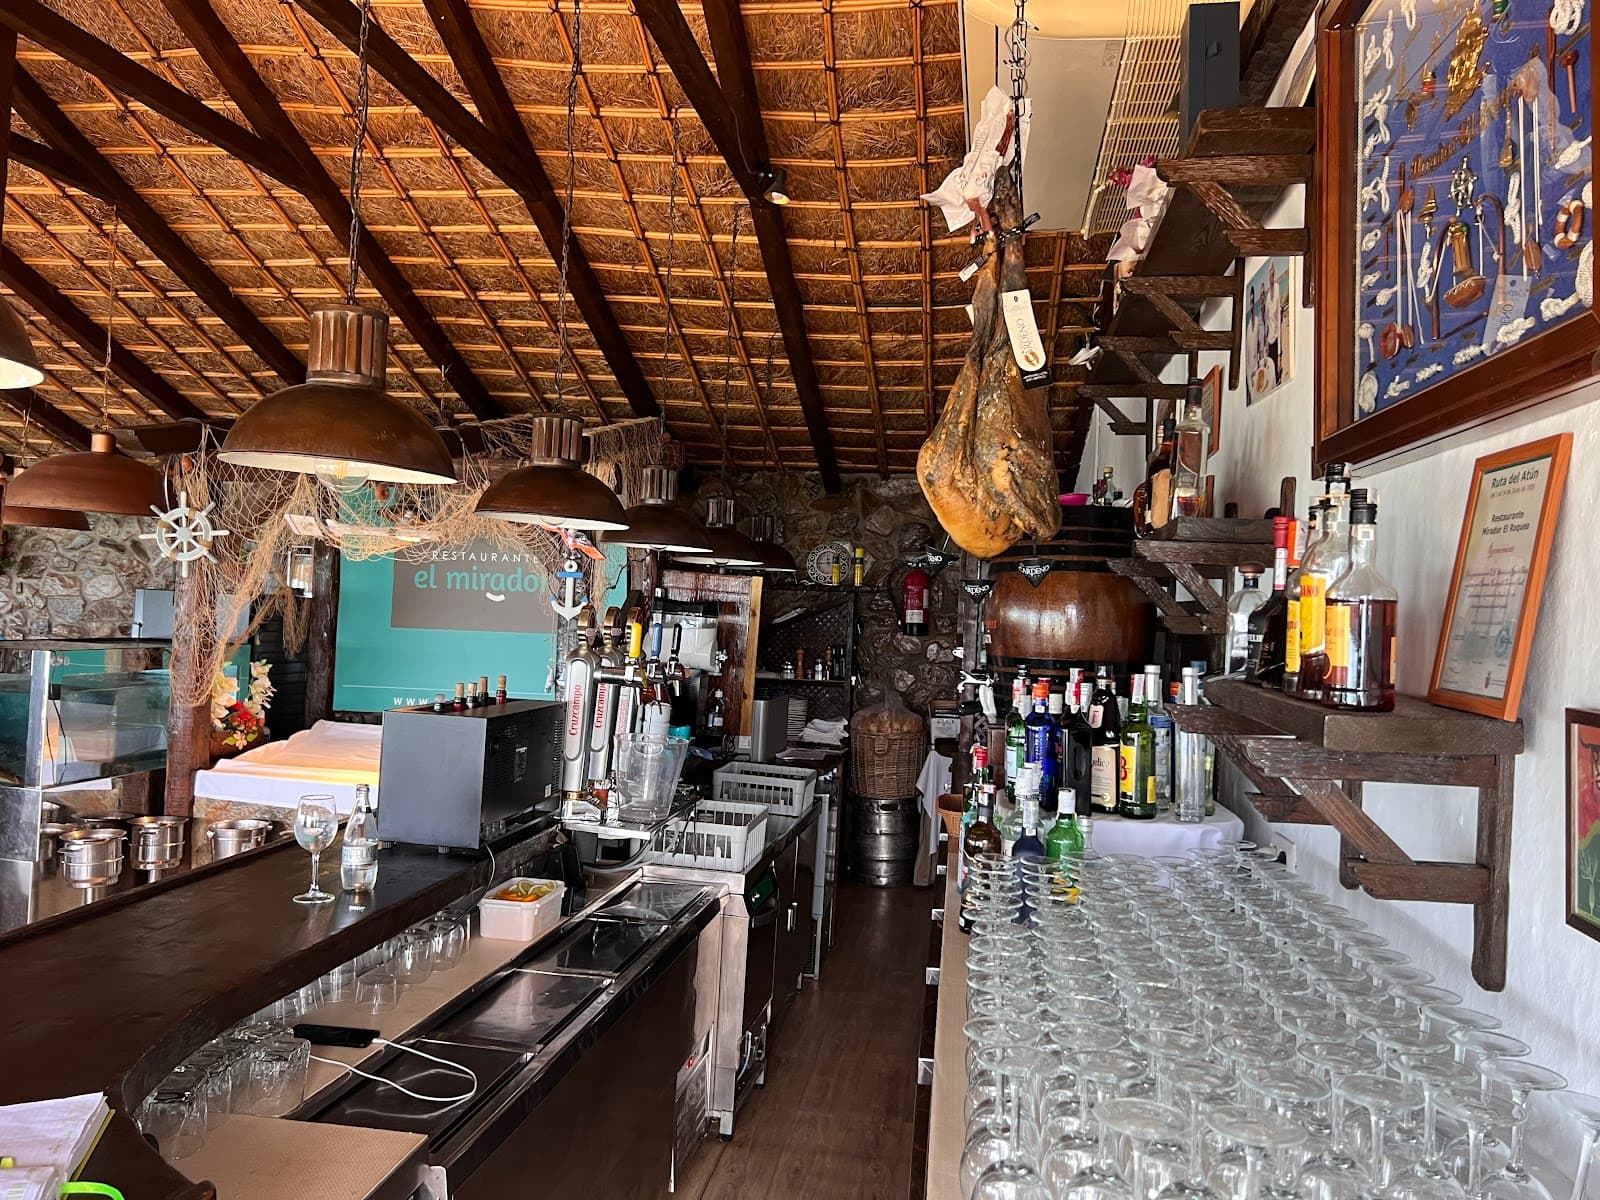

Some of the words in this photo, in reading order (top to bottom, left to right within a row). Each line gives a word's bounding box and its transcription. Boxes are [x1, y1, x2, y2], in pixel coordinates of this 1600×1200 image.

[1491, 477, 1507, 488] Ruta
[1508, 471, 1520, 485] del
[1521, 467, 1539, 483] Atún
[1491, 511, 1525, 522] Restaurante
[1482, 526, 1502, 536] Mirador
[1503, 524, 1509, 534] El
[432, 550, 540, 564] RESTAURANTE
[414, 564, 437, 590] el
[568, 684, 583, 736] Cruzcampo
